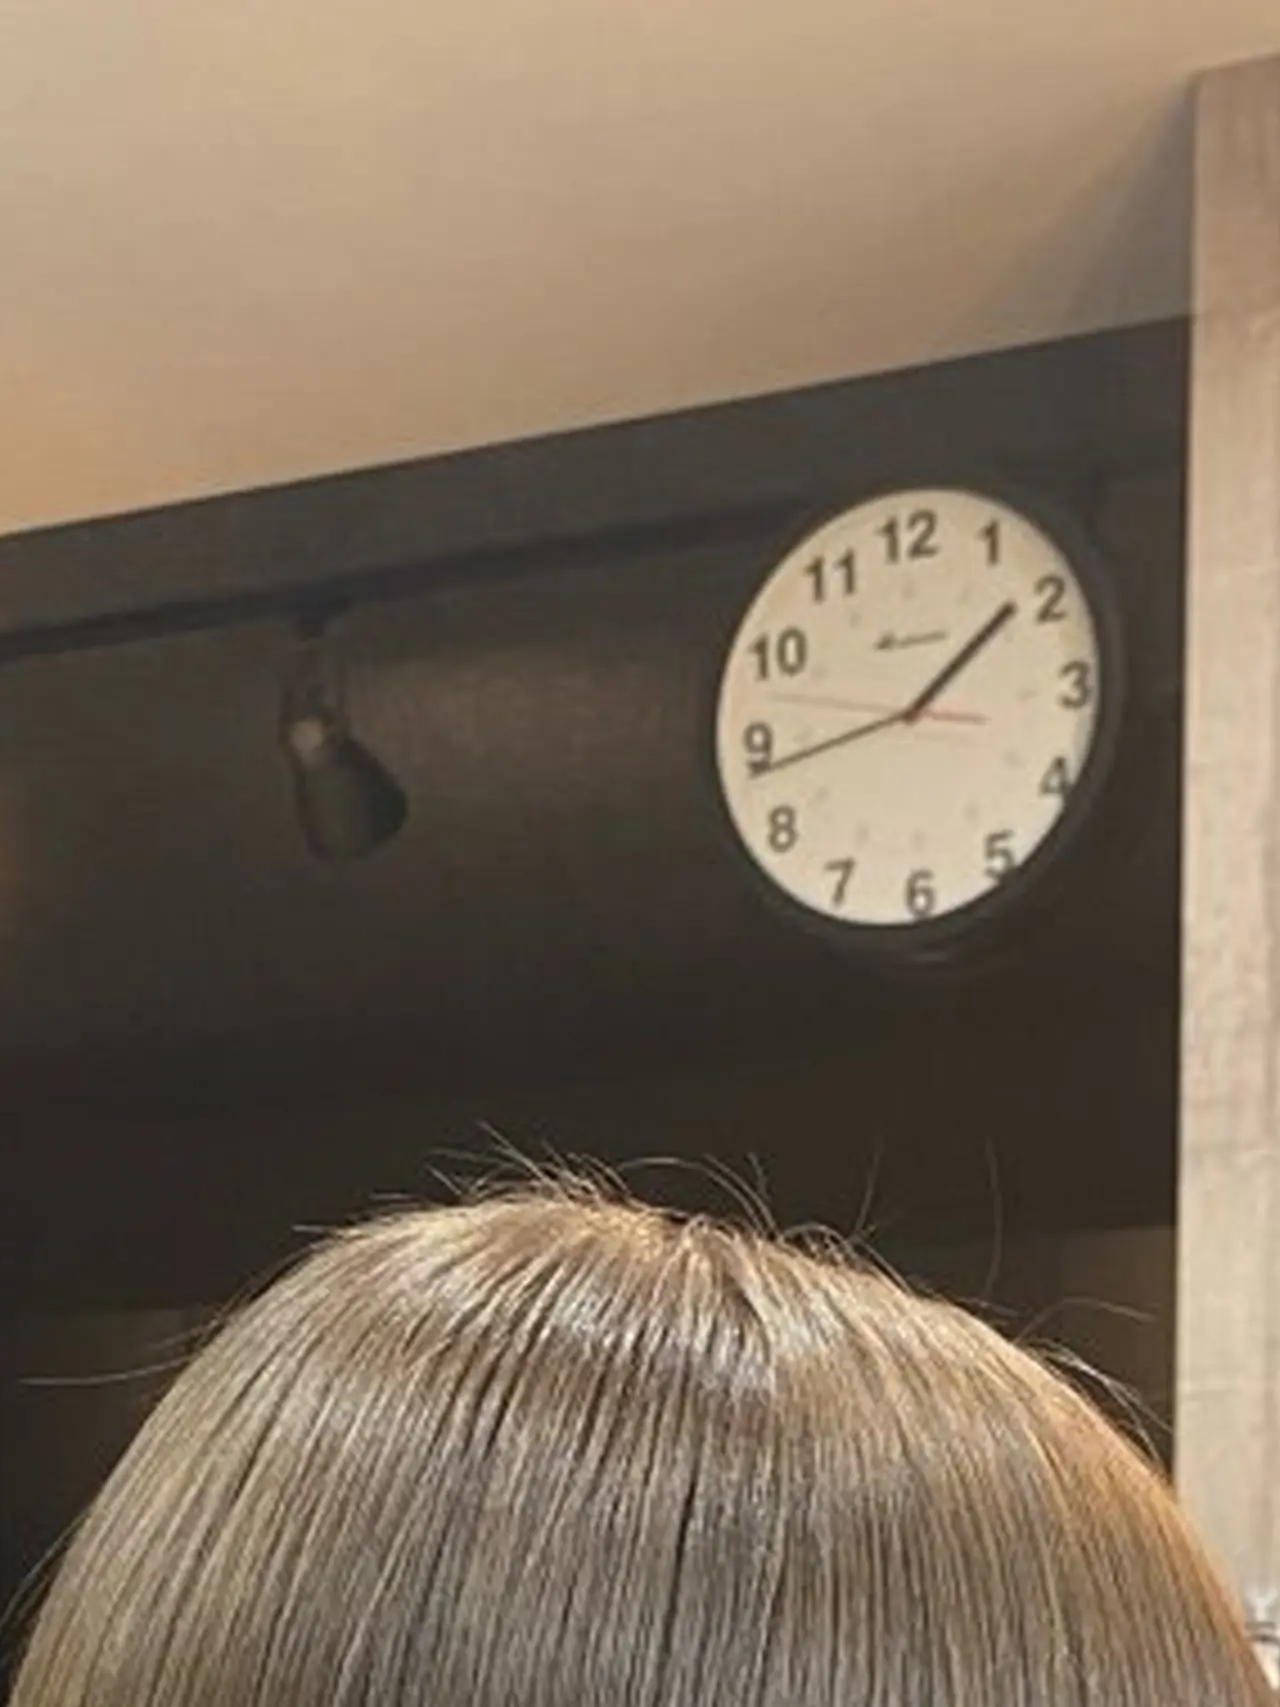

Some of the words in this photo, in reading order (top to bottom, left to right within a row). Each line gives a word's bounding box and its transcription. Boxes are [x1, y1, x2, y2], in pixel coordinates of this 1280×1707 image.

[877, 509, 940, 565] 12
[978, 519, 1002, 567] 1
[803, 548, 858, 604] 11
[1032, 574, 1067, 624] 2
[748, 626, 808, 681] 10
[1058, 659, 1091, 710] 3
[742, 720, 774, 773] 9
[1038, 756, 1072, 798] 4
[766, 805, 799, 853] 8
[824, 856, 856, 907] 7
[983, 829, 1016, 883] 5
[904, 869, 936, 918] 6
